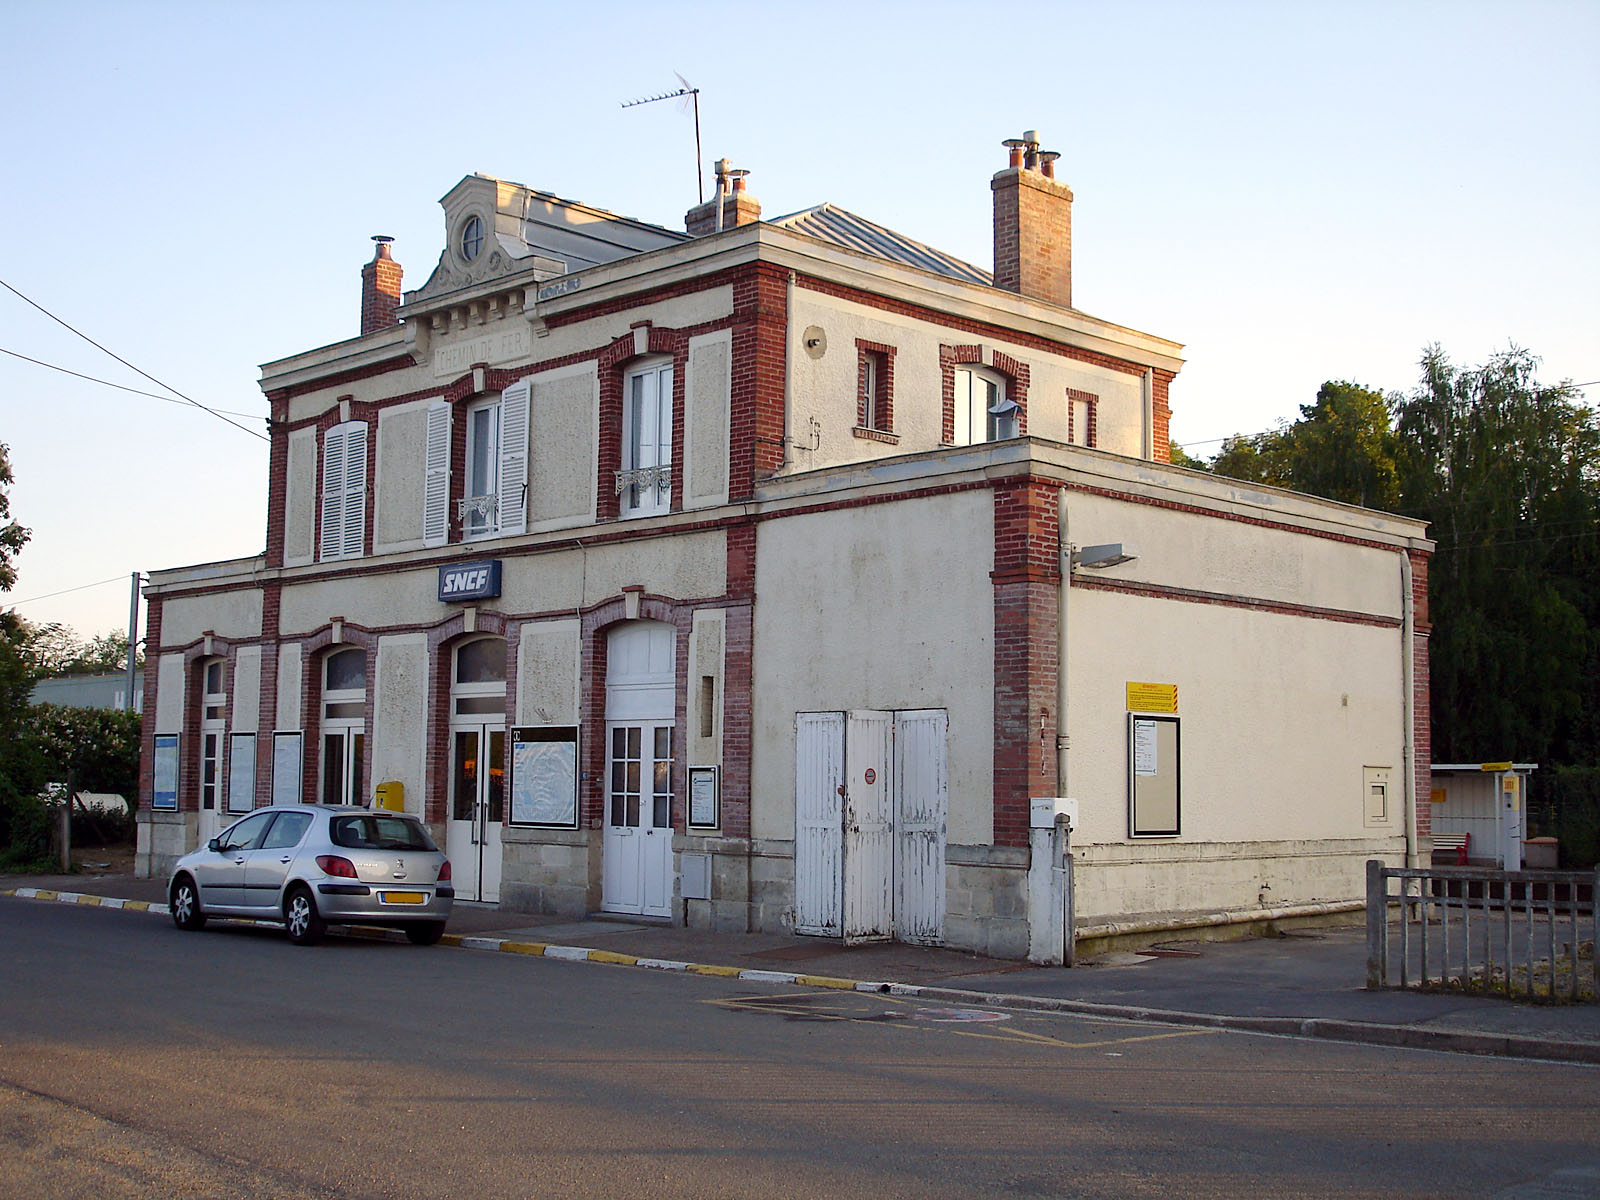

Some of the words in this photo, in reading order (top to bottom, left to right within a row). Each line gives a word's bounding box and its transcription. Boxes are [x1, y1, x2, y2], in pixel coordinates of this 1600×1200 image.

[440, 344, 477, 370] CHEMIN
[481, 340, 493, 361] DE
[502, 333, 523, 355] FER
[443, 570, 488, 593] SNCF
